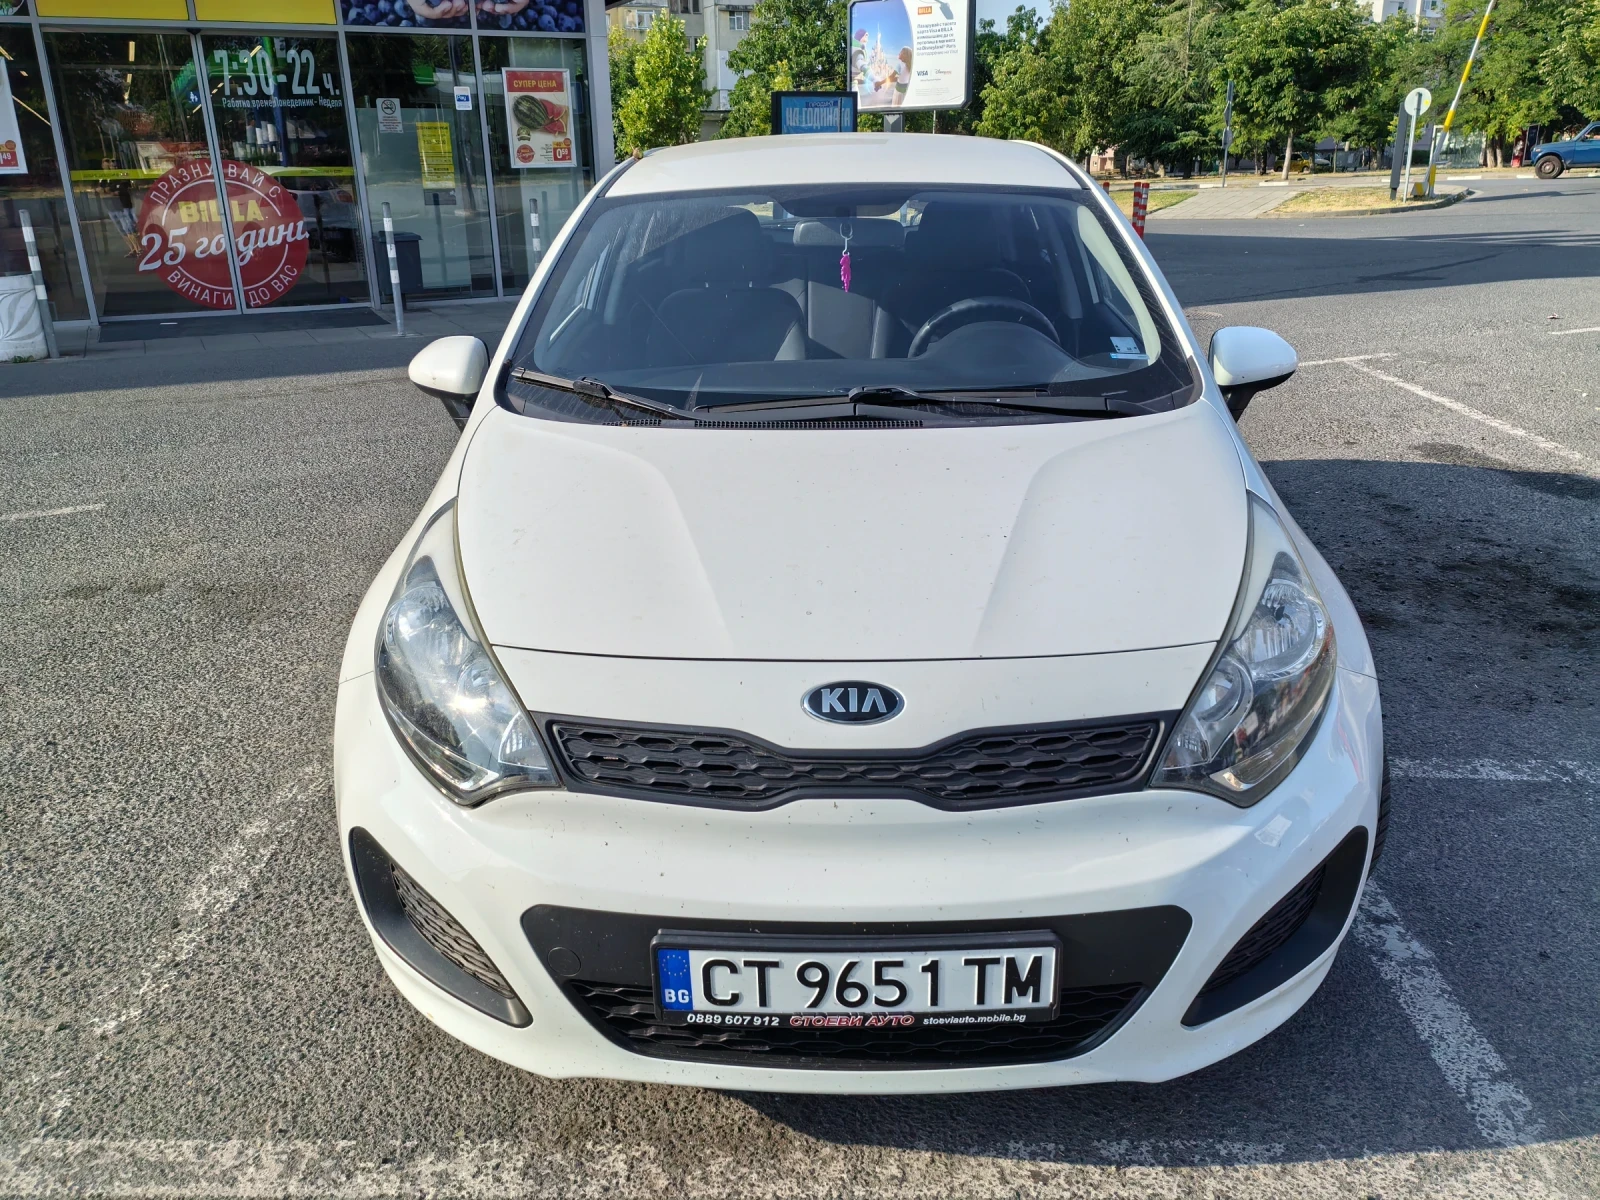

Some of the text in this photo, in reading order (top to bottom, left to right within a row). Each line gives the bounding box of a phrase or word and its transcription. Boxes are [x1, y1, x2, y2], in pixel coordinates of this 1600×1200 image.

[538, 80, 557, 89] ЦЕНА
[222, 98, 250, 108] Работно
[319, 96, 342, 108] Неделя
[786, 108, 798, 126] НА
[178, 199, 264, 223] BILLA
[139, 226, 188, 272] 25
[167, 264, 298, 307] ВИНАГИ ДО ВАС
[821, 688, 887, 712] KIA
[702, 956, 1042, 1008] CT 9651 TM
[664, 988, 690, 1004] BG
[687, 1013, 1026, 1026] 0889 607 912 СТОЕВИ АУТО stoeviauto.mobile.bg
